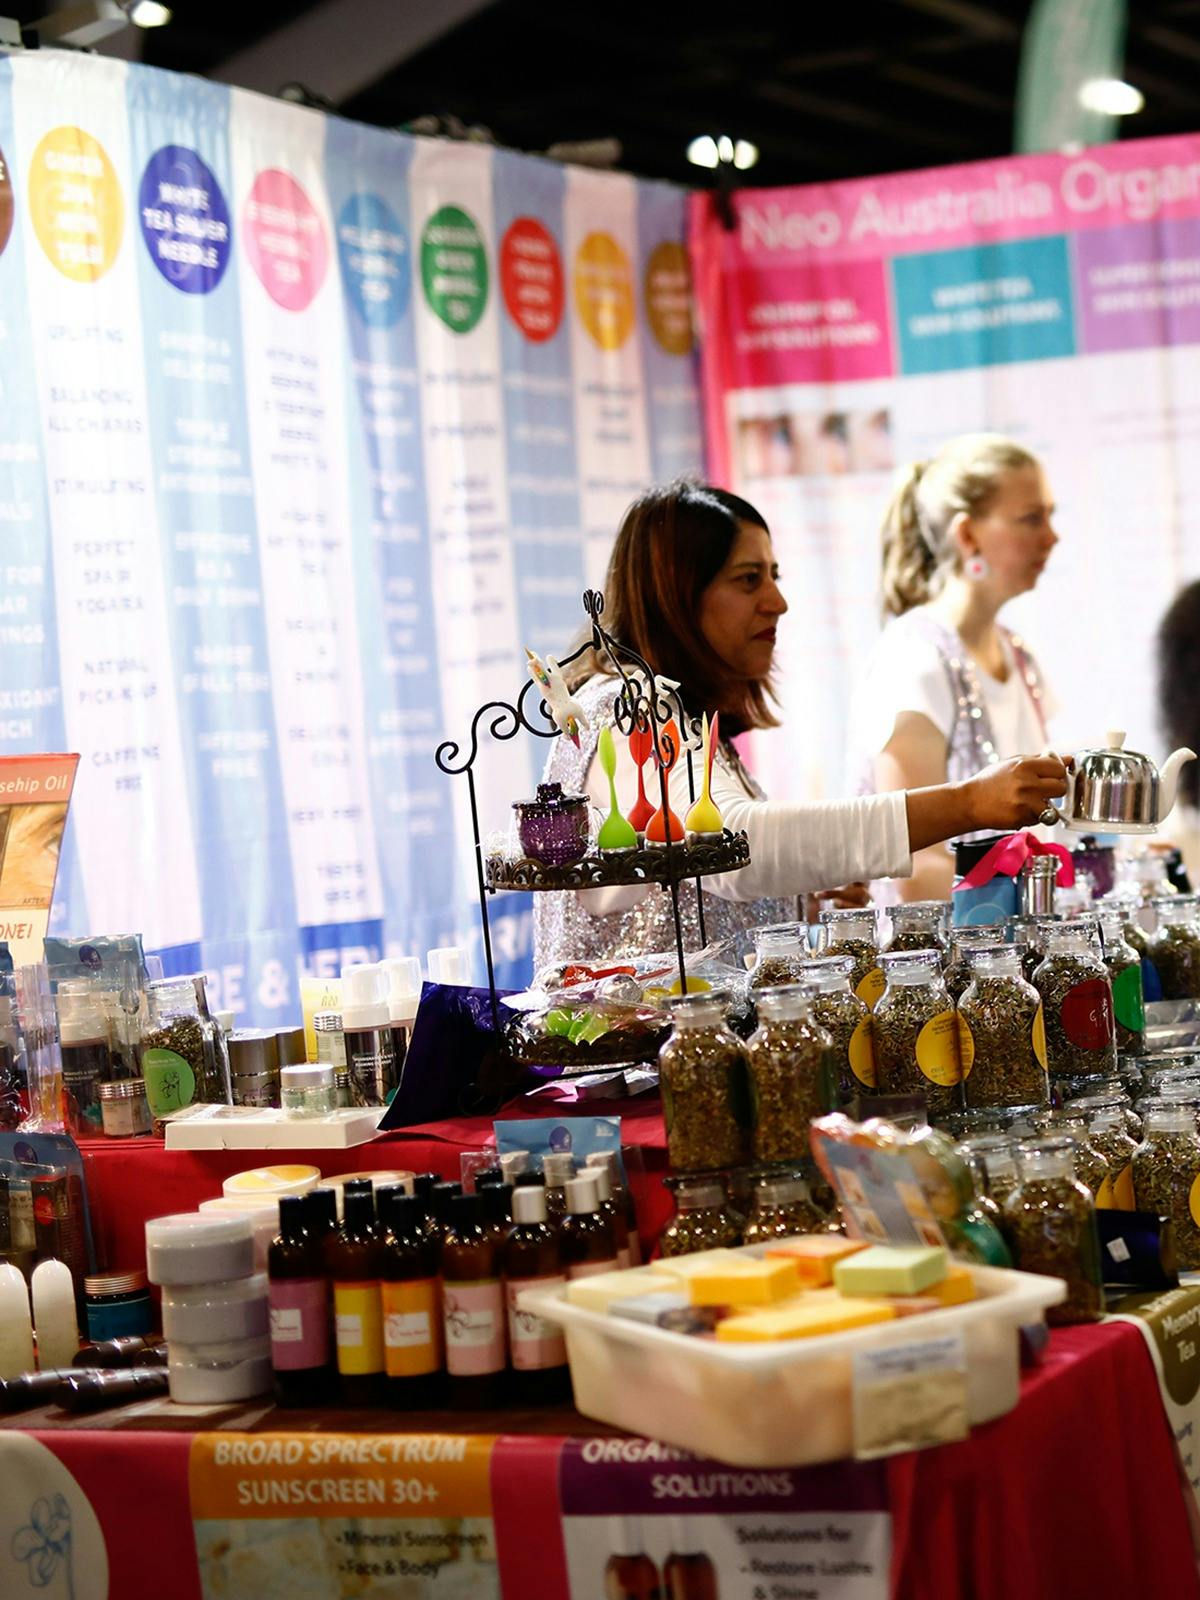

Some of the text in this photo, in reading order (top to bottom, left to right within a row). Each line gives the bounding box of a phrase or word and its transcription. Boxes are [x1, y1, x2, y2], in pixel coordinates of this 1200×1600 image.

[159, 182, 210, 212] WHITE
[741, 205, 841, 251] Neo
[848, 172, 1053, 244] Australia
[45, 774, 68, 791] Oil
[1177, 1340, 1196, 1363] Tea
[214, 1437, 468, 1466] BROAD SPRECTRUM
[237, 1478, 440, 1505] SUNSCREEN 30+
[651, 1473, 794, 1499] SOLUTIONS
[343, 1529, 488, 1546] Mineral Sunscreen
[737, 1524, 852, 1545] Solutions for
[346, 1558, 440, 1580] Face & Body
